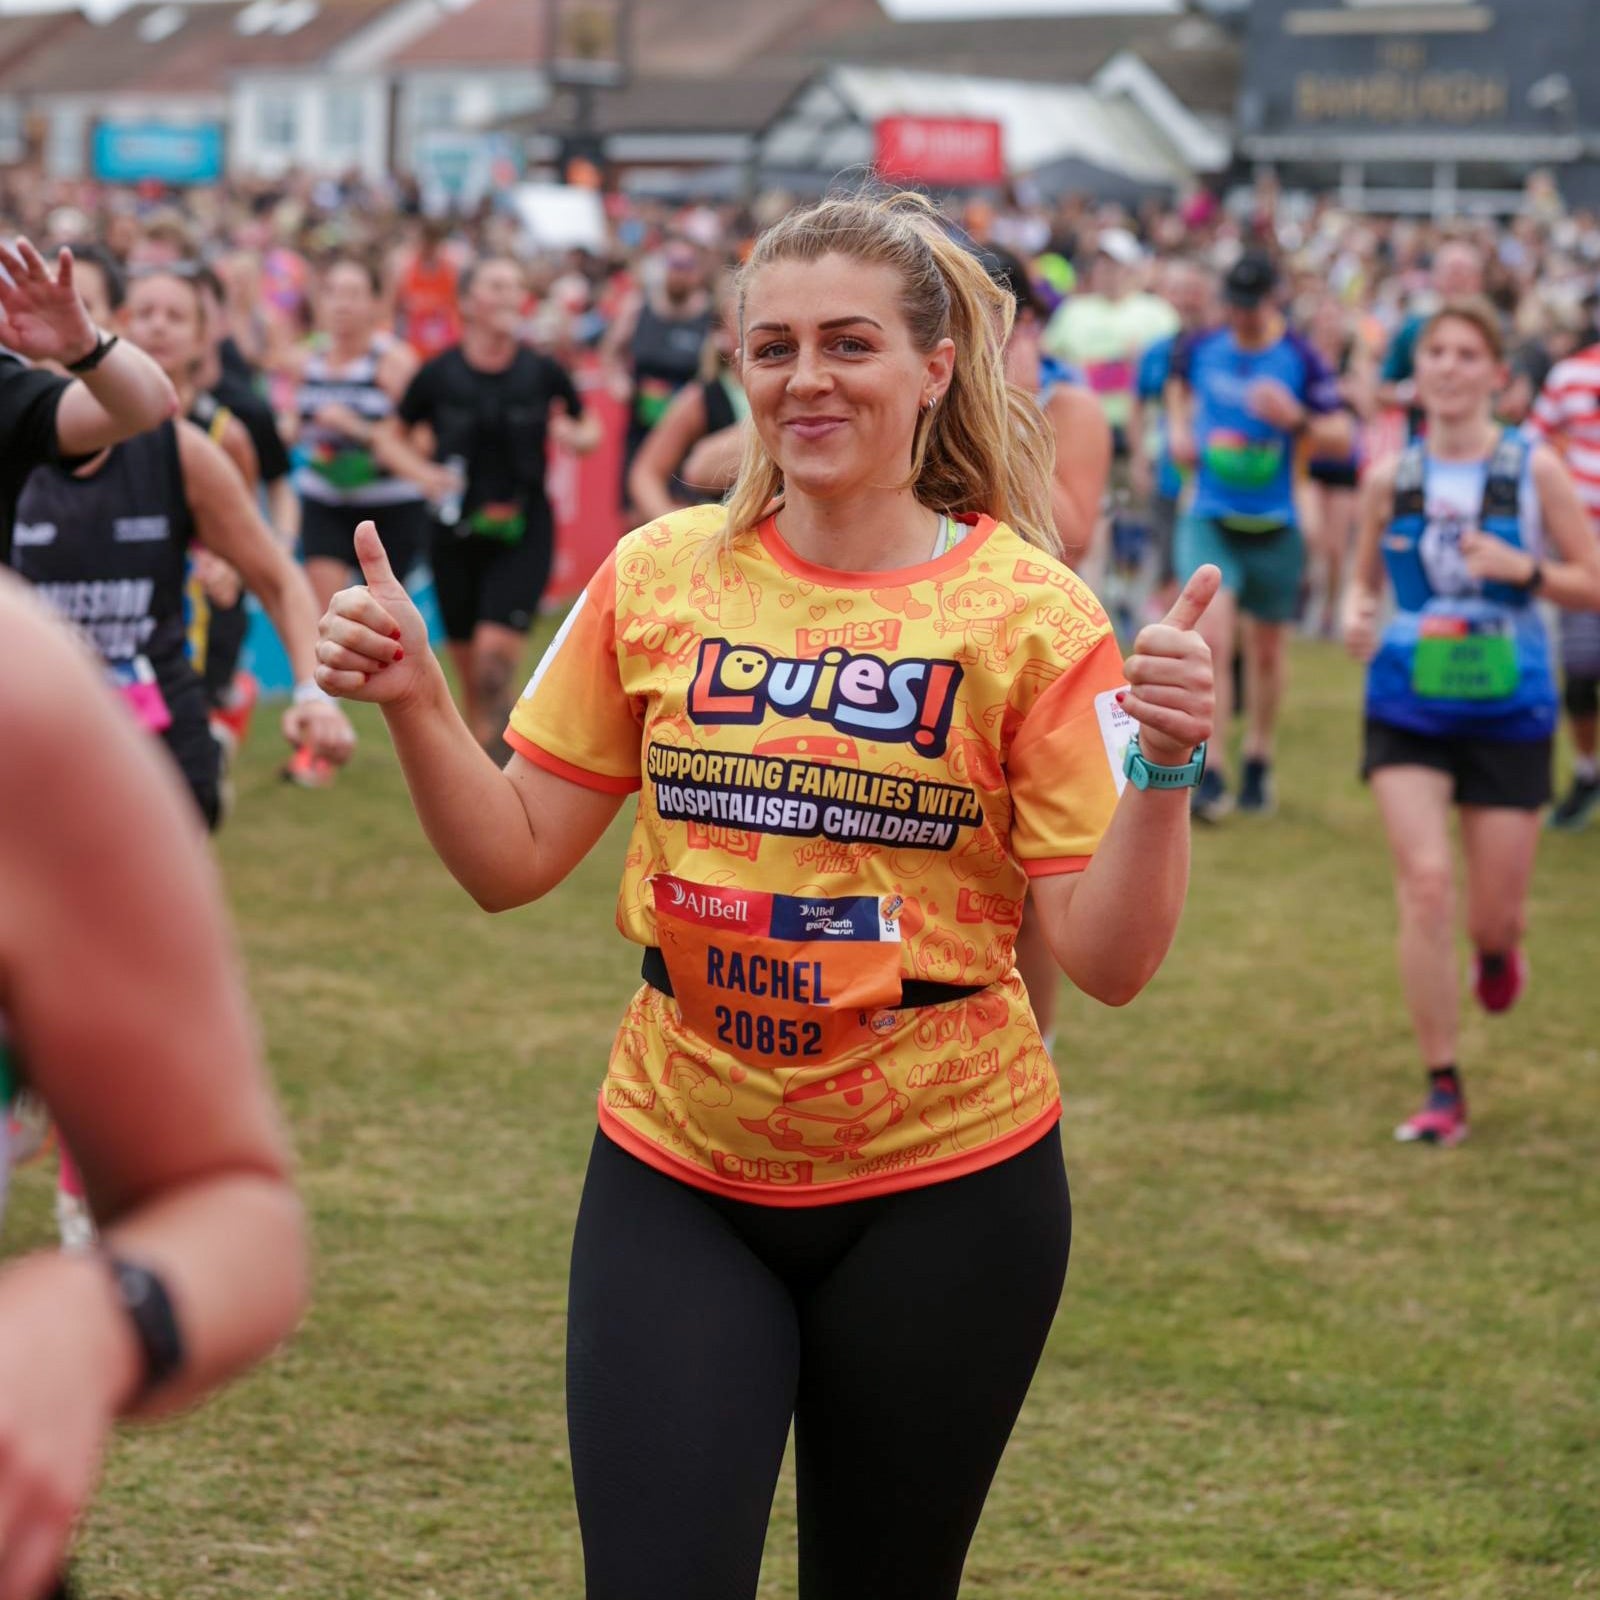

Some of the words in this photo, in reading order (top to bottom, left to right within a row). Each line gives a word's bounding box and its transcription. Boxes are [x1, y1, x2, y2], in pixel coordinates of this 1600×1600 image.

[622, 617, 702, 663] WOW!
[796, 619, 901, 658] Louies!
[690, 640, 960, 750] Louies!
[648, 745, 784, 790] SUPPORTING
[787, 764, 913, 811] FAMILIES
[917, 786, 979, 819] WITH
[658, 783, 818, 830] HOSPITALISED
[823, 806, 952, 846] CHILDREN
[815, 855, 860, 875] THIS!
[829, 919, 853, 929] north
[707, 945, 831, 1004] RACHEL
[715, 1005, 823, 1057] 20852
[906, 1047, 999, 1088] AMAZING!
